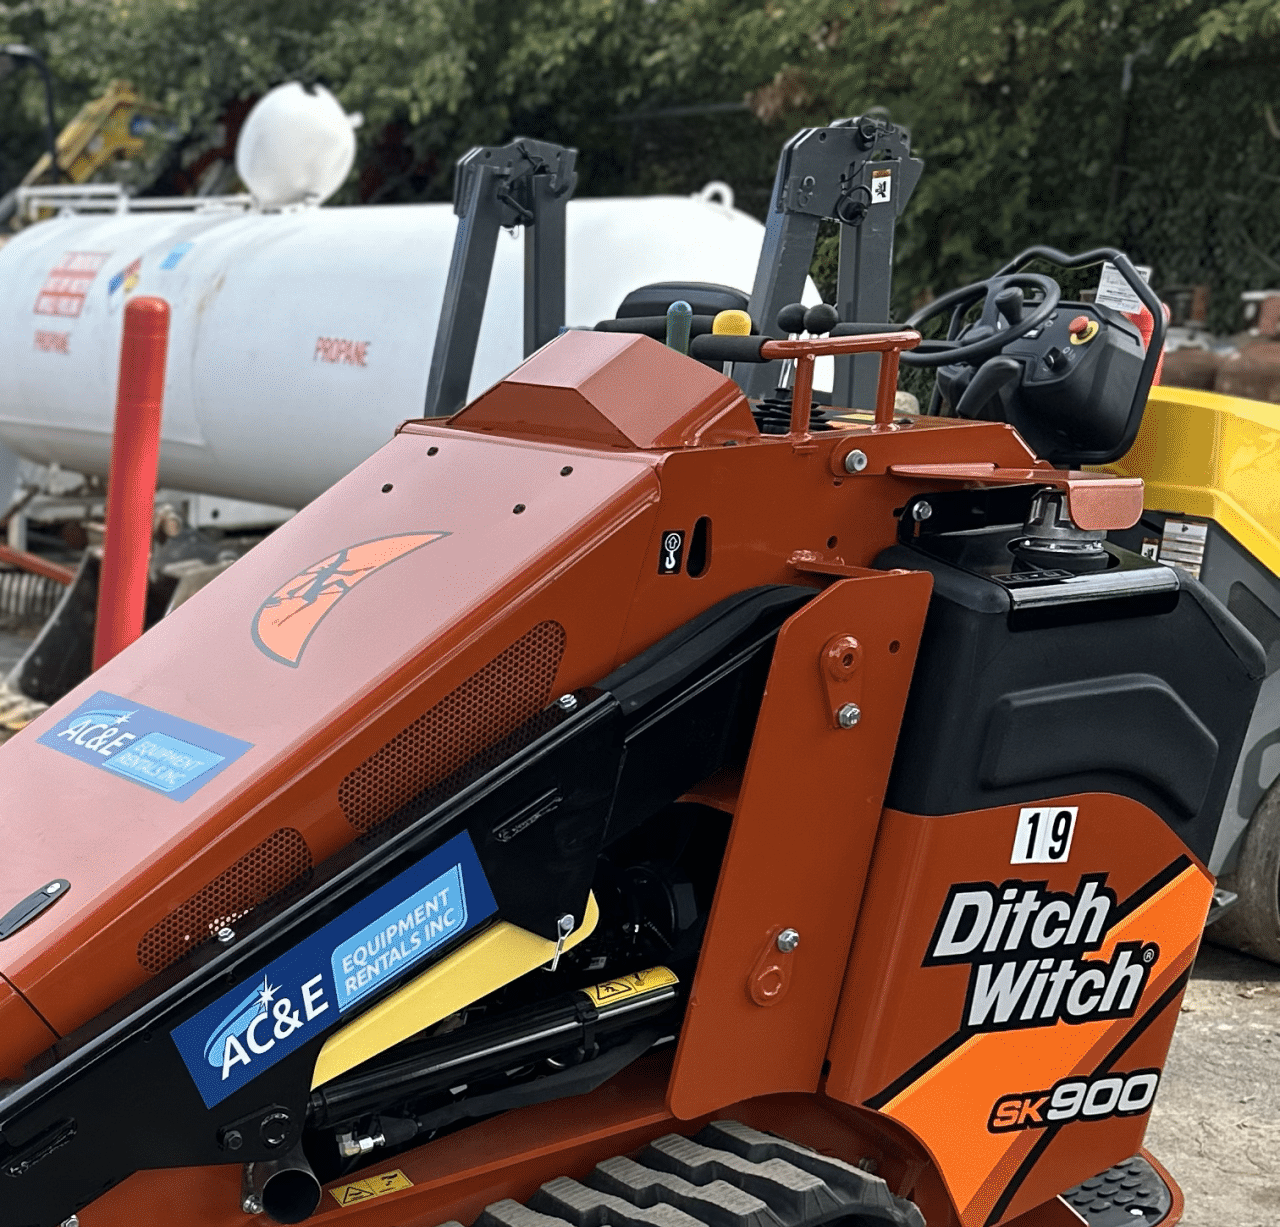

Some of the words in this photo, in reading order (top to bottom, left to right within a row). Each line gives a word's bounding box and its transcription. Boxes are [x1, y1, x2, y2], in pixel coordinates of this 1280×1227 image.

[313, 335, 372, 368] PROPANE
[57, 718, 137, 757] AC&E
[1025, 810, 1073, 860] 19
[341, 886, 450, 975] EQUIPMENT
[344, 933, 423, 996] RENTALS
[424, 906, 457, 942] INC
[932, 881, 1112, 958] Ditch
[967, 950, 1145, 1026] Witch
[221, 973, 330, 1082] AC&E
[992, 1073, 1159, 1128] SK900
